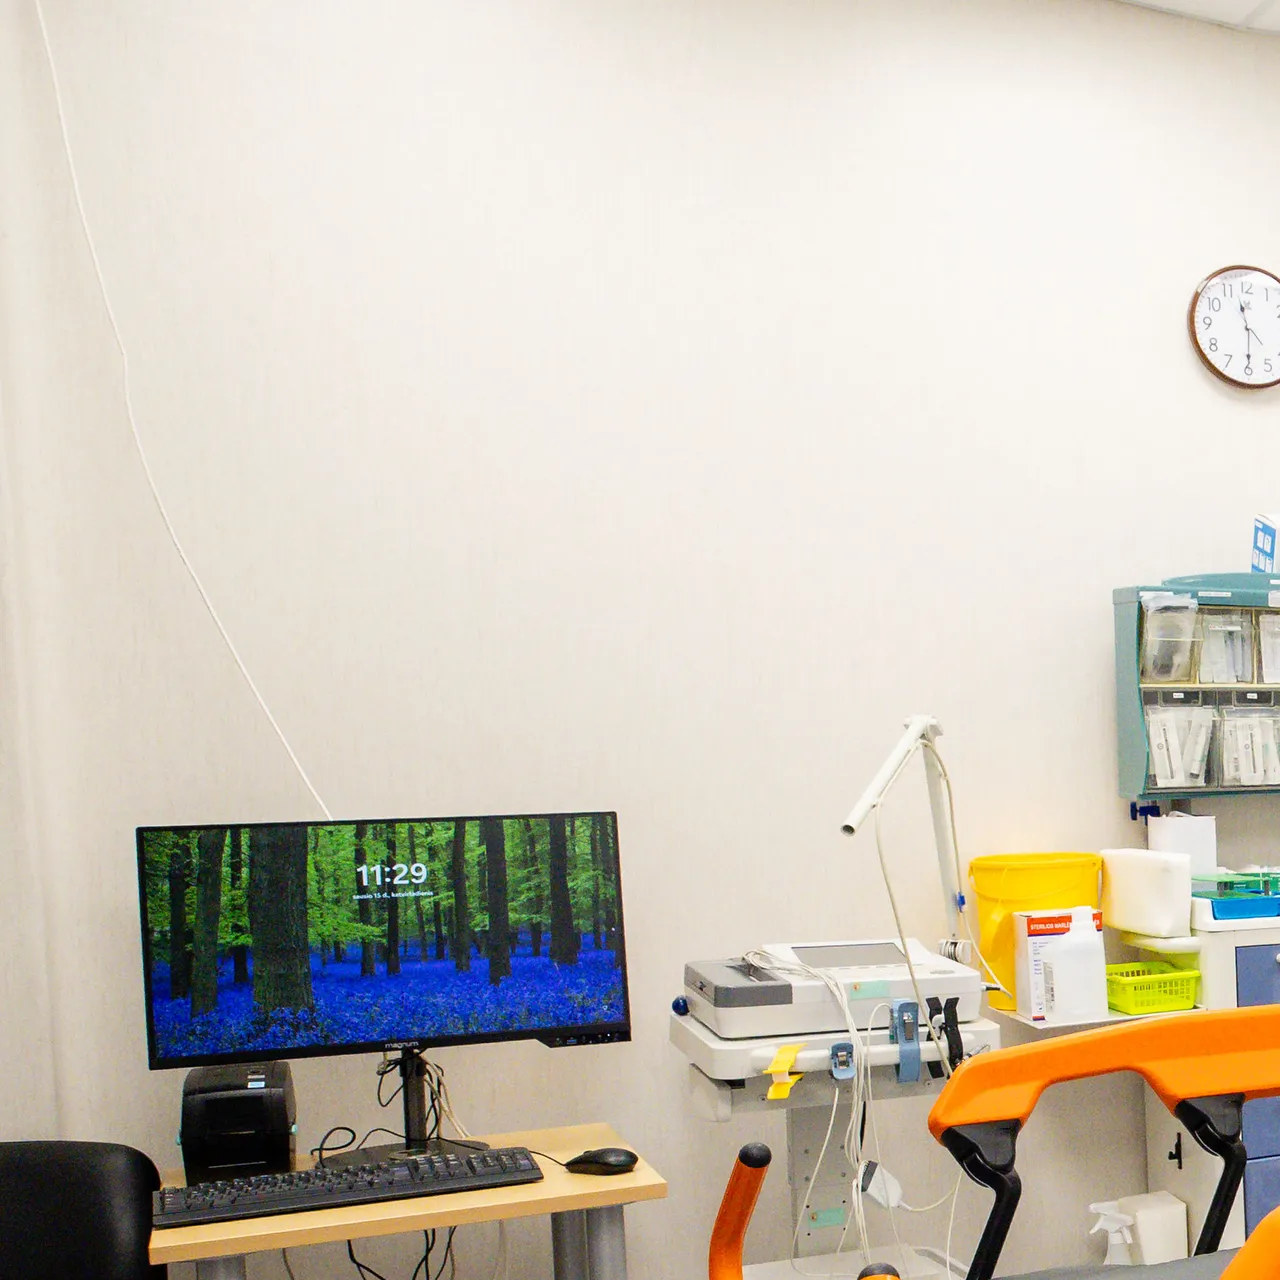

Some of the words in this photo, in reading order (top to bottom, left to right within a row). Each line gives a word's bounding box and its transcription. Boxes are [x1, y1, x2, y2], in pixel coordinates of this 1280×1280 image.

[1222, 283, 1233, 298] 11
[1240, 281, 1253, 295] 12
[1264, 288, 1269, 301] 1
[1208, 297, 1221, 312] 10
[1203, 317, 1212, 330] 9
[1209, 338, 1218, 352] 8
[1224, 354, 1233, 368] 7
[1264, 359, 1273, 372] 5
[1244, 362, 1253, 376] 6
[357, 863, 427, 886] 11:29
